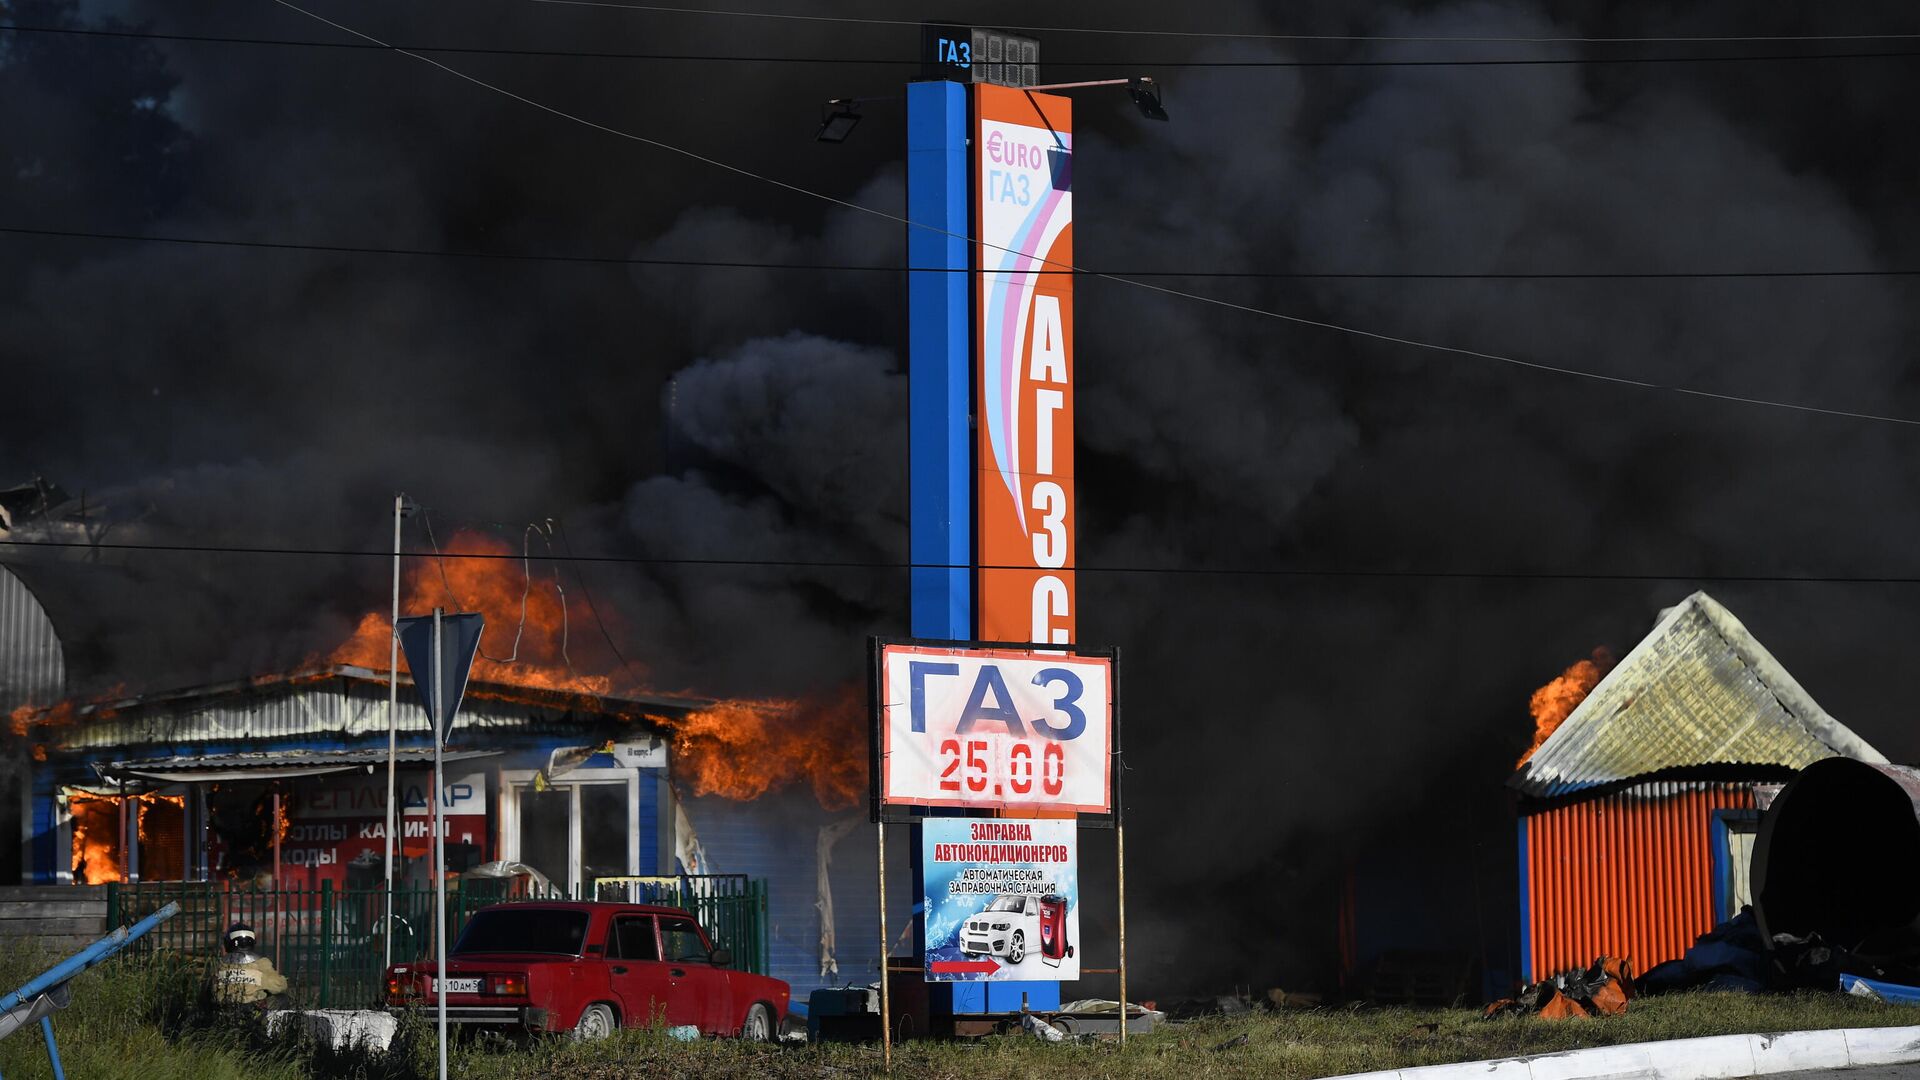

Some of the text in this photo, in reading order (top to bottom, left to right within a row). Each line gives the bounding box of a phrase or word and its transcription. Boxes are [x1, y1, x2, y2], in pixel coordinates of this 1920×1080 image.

[938, 38, 971, 68] ГАЗ
[989, 170, 1031, 207] ГАЗ
[1029, 294, 1069, 656] АГЗС
[909, 661, 1087, 741] ГАЗ
[939, 739, 1065, 796] 25.00
[289, 820, 450, 842] ОТЛЫ КАИНЫ
[971, 823, 1032, 841] ЗАПРАВКА
[935, 844, 1068, 864] АВТОКОНДИЦИОНЕРОВ
[949, 882, 1056, 894] ЗАПРАВОЧНАЯ СТАНЦИЯ
[963, 869, 1043, 881] АВТОМАТИЧЕСКАЯ
